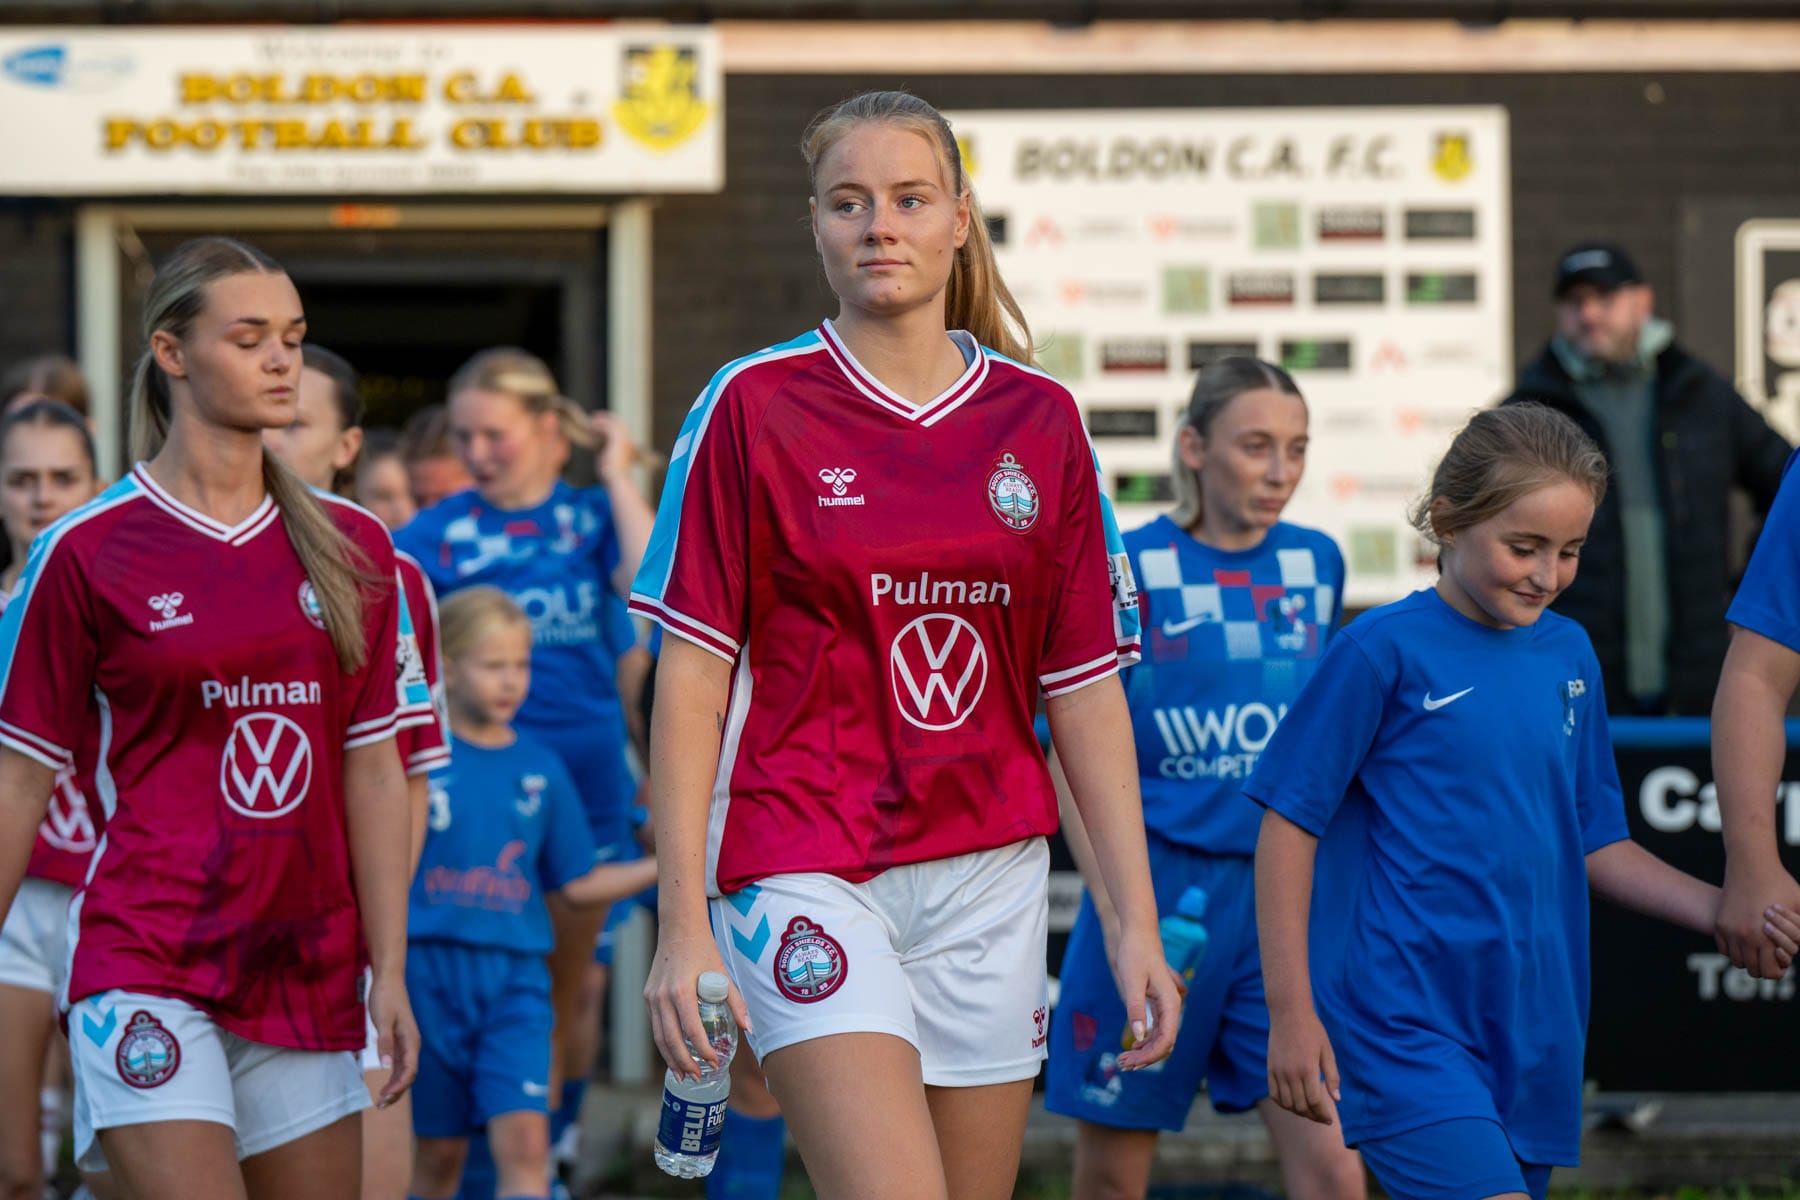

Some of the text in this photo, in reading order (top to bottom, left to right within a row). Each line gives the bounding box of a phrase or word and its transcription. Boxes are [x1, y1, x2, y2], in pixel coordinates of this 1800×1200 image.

[180, 72, 427, 104] BOLDON
[104, 118, 603, 152] FOOTBALL CLUB
[1014, 137, 1214, 182] BOLDON
[818, 494, 865, 507] hummel
[871, 572, 1011, 607] Pulman
[149, 612, 194, 632] hummel
[201, 676, 321, 709] Pulman
[1182, 702, 1287, 752] WO
[1160, 753, 1260, 779] COMPET
[781, 946, 795, 968] SOUTH
[795, 938, 825, 947] SHIELDS
[680, 1104, 707, 1152] BELU
